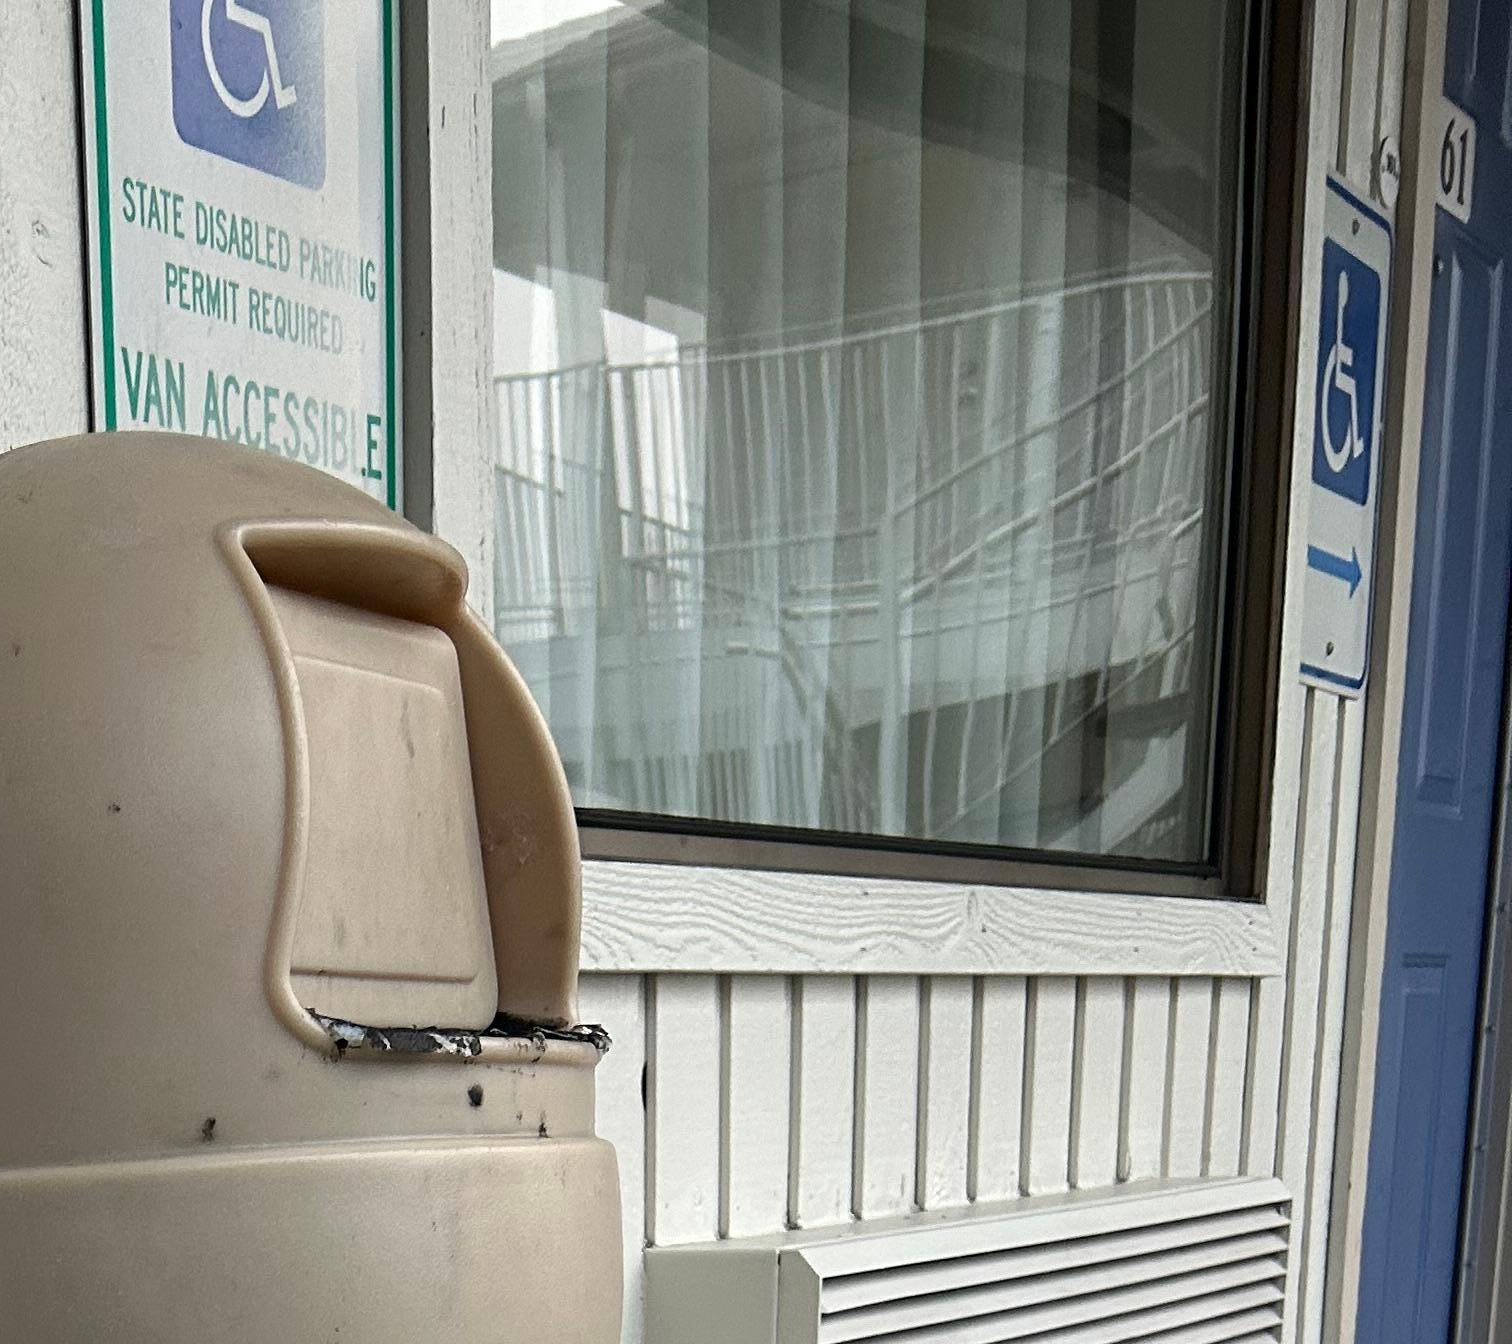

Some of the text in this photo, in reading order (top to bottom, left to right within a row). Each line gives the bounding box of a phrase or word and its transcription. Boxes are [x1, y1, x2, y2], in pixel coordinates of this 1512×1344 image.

[1440, 117, 1469, 206] 61
[122, 176, 185, 240] STATE
[195, 200, 291, 273] DISABLED
[164, 261, 345, 355] PERMIT REQUIRED
[121, 345, 187, 432] VAN
